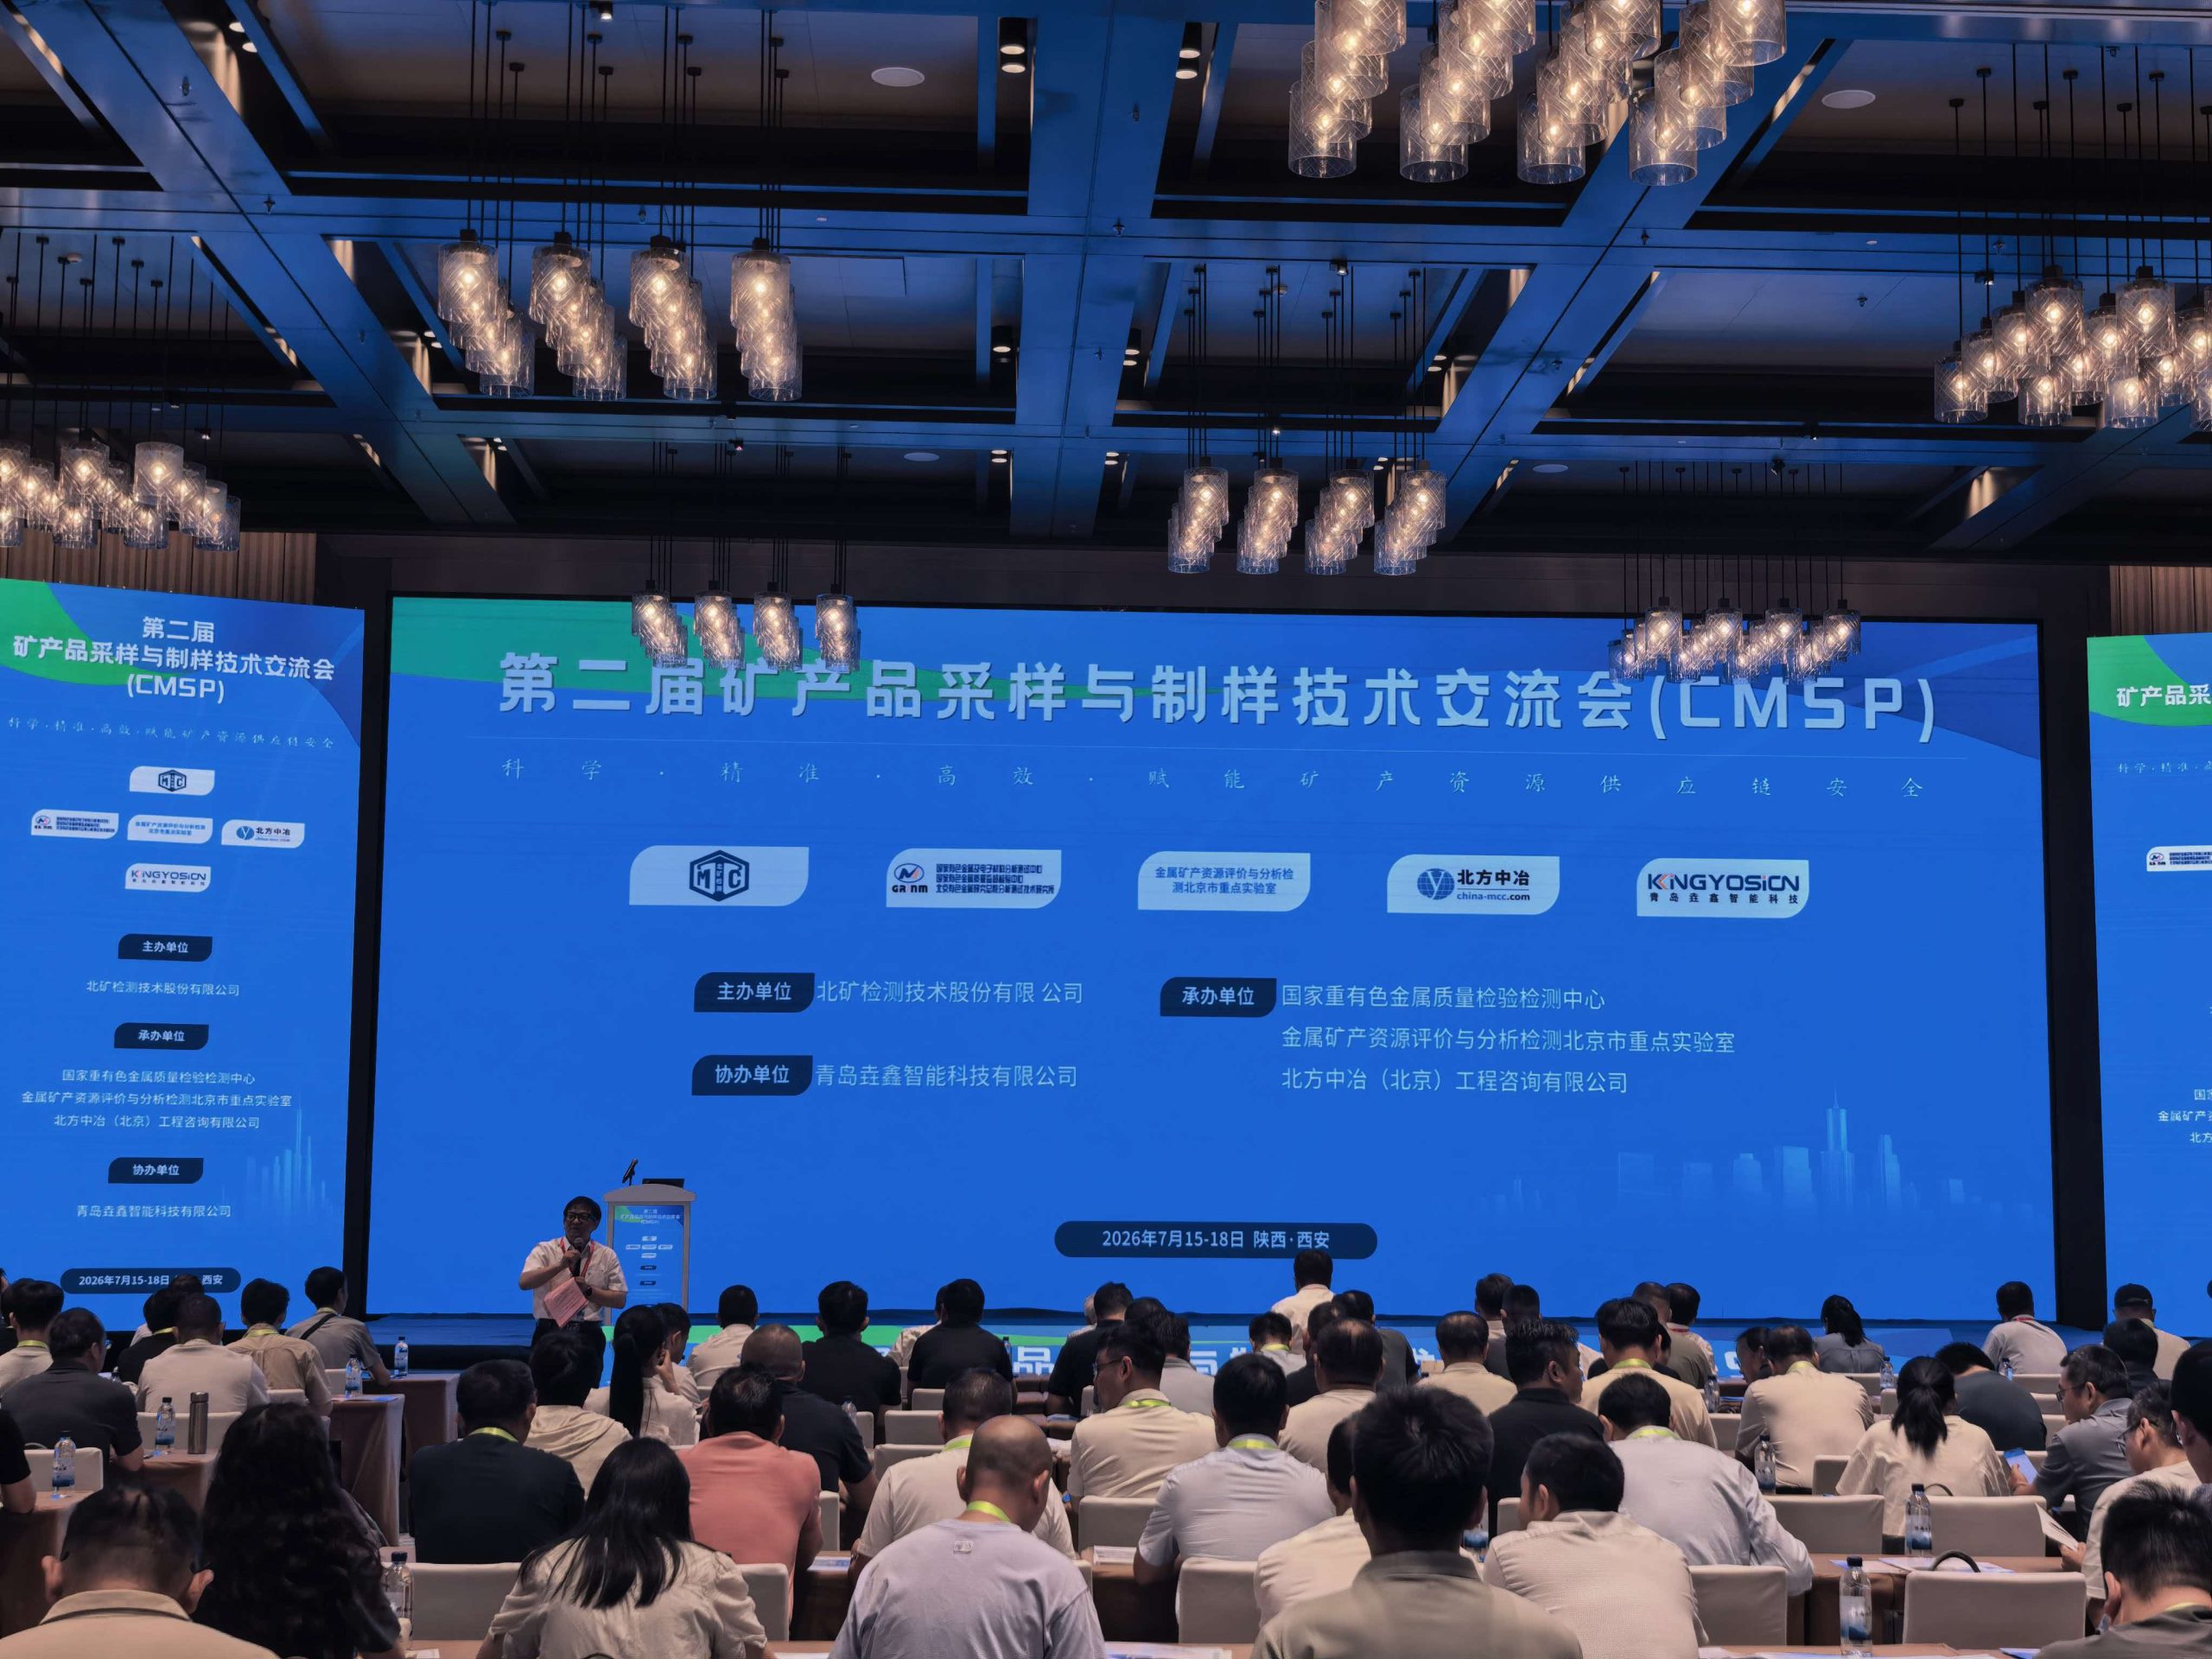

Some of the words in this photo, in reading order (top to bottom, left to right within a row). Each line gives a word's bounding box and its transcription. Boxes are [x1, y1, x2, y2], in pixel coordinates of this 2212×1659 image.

[143, 616, 214, 644] 第二届
[13, 635, 335, 681] 矿产品采样与制样技术交流会
[127, 673, 225, 703] (CMSP)
[2116, 683, 2212, 707] 矿产品采
[1155, 866, 1294, 880] 金属矿产资源评价与分析检
[1457, 869, 1530, 887] 北方中冶
[1172, 881, 1277, 895] 测北京市重点实验室
[1457, 892, 1530, 901] china-mcc.com
[1649, 892, 1799, 905] 青岛垚鑫智能科技
[143, 940, 188, 953] 主办单位
[86, 980, 239, 996] 北矿检测技术股份有限公司
[717, 982, 792, 1001] 主办单位
[1181, 986, 1255, 1006] 承办单位
[1282, 984, 1605, 1010] 国家重有色金属质量检验检测中心
[138, 1029, 185, 1042] 承办单位
[1281, 1026, 1735, 1054] 金属矿产资源评价与分析检测北京市重点实验室
[62, 1069, 256, 1085] 国家重有色金属质量检验检测中心
[715, 1064, 790, 1084] 协办单位
[816, 1064, 1077, 1087] 青岛垚鑫智能科技有限公司
[1281, 1068, 1628, 1094] 北方中冶（北京）工程咨询有限公司
[22, 1090, 292, 1107] 金属矿产资源评价与分析检测北京市重点实验室
[132, 1164, 180, 1176] 协办单位
[77, 1205, 231, 1217] 青岛垚鑫智能科技有限公司
[1102, 1229, 1244, 1248] 2026年7月15-18日
[1253, 1230, 1330, 1249] 陕西·西安
